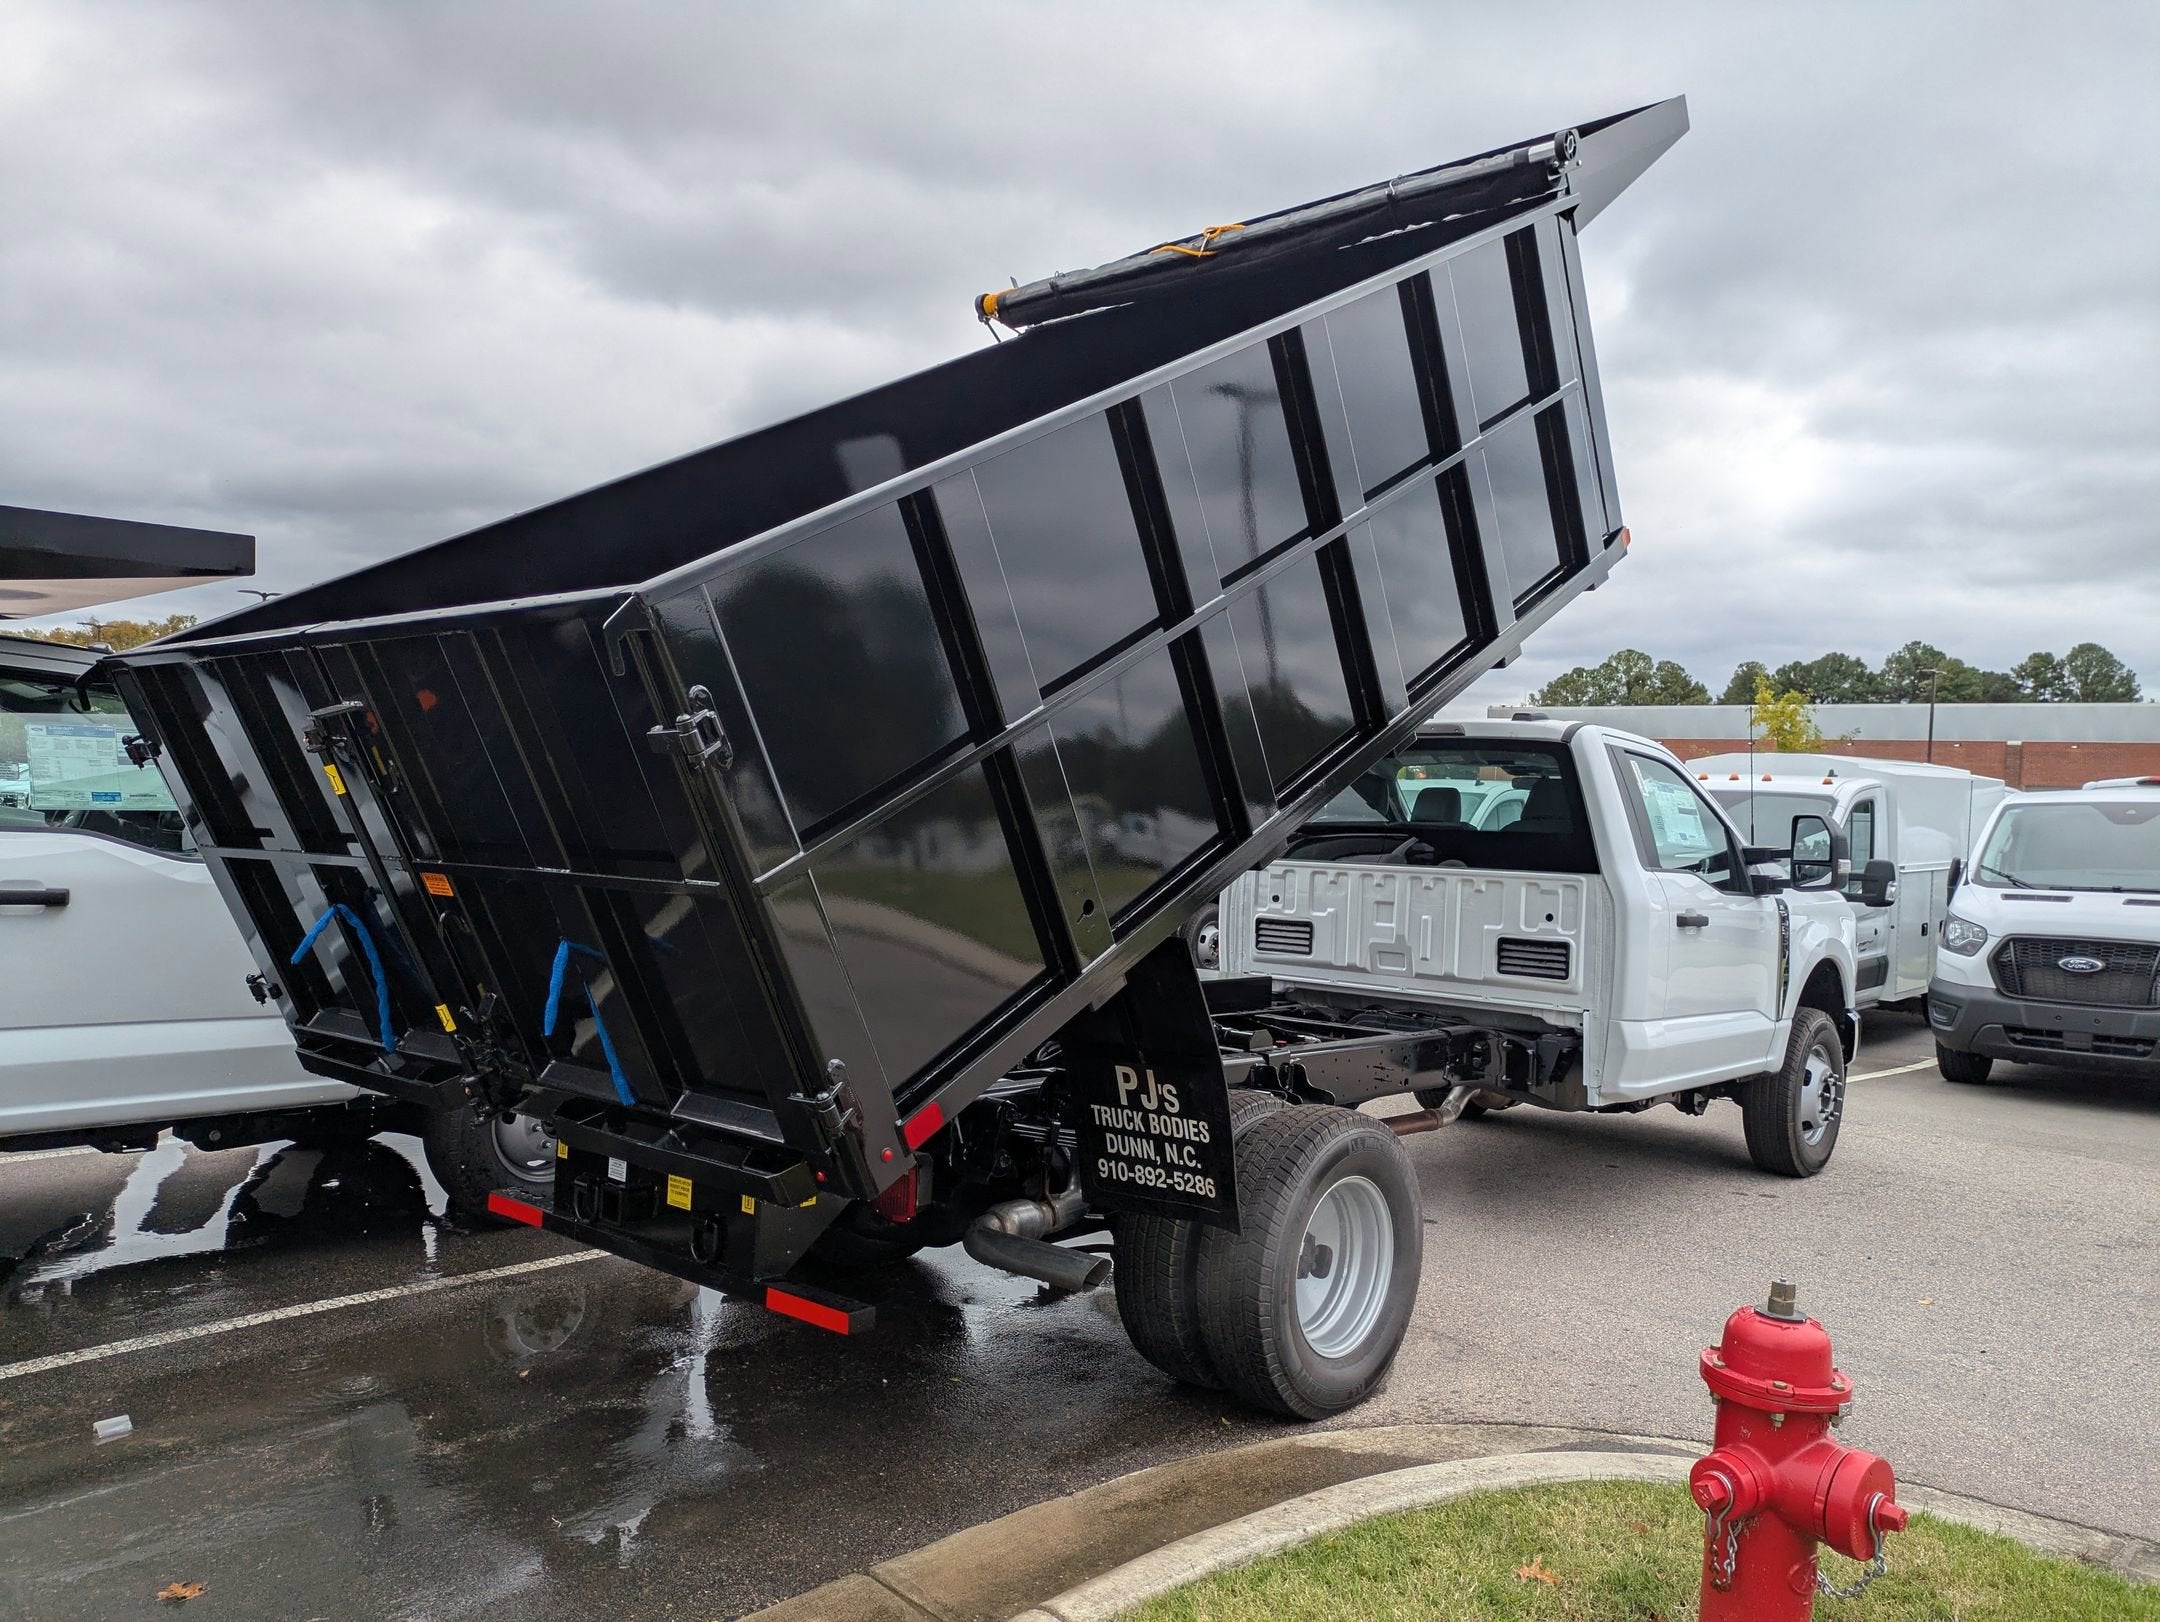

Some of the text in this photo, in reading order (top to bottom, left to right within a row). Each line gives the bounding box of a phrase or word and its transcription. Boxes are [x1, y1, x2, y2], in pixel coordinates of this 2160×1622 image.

[1090, 1104, 1210, 1144] TRUCK BODIES
[1105, 1132, 1202, 1169] DUNN, N.C.
[1098, 1158, 1216, 1198] 910-892-5286
